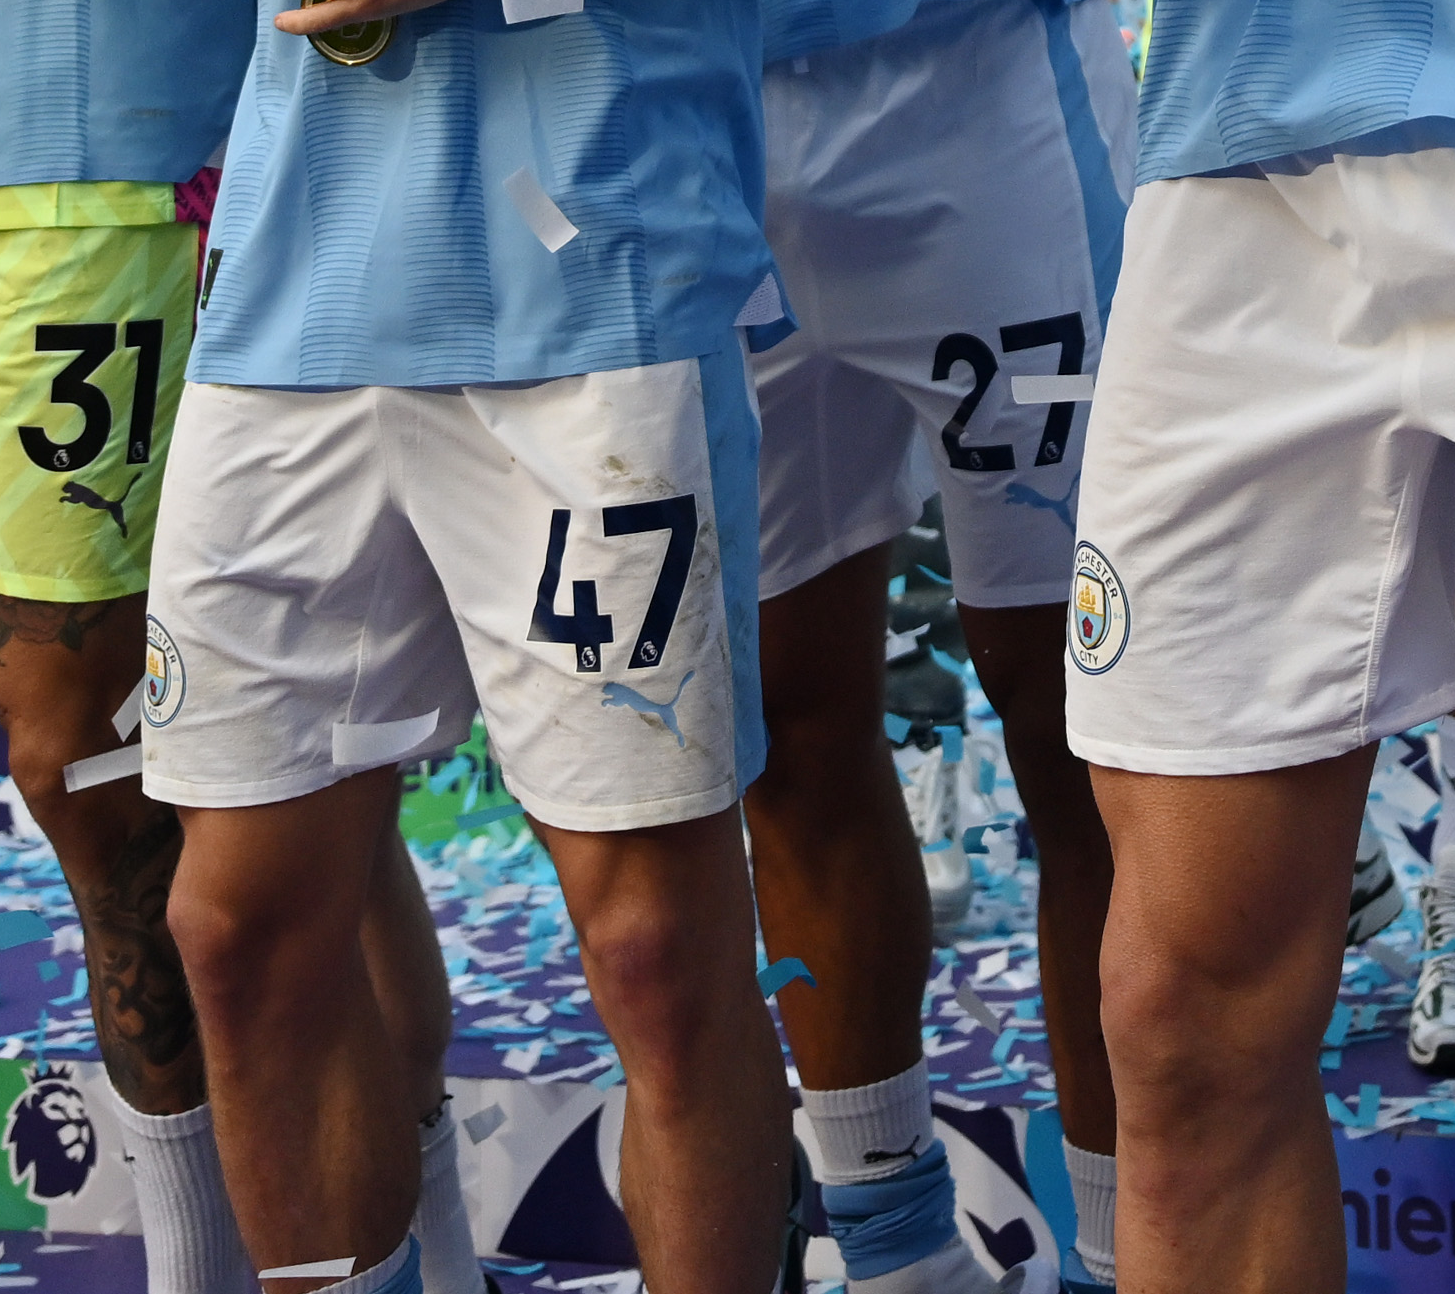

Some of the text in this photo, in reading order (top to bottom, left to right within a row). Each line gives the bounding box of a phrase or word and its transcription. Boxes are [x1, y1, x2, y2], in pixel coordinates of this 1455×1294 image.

[19, 319, 163, 472] 31
[931, 311, 1085, 473] 27
[526, 493, 699, 673] 47
[1077, 648, 1099, 666] CITY
